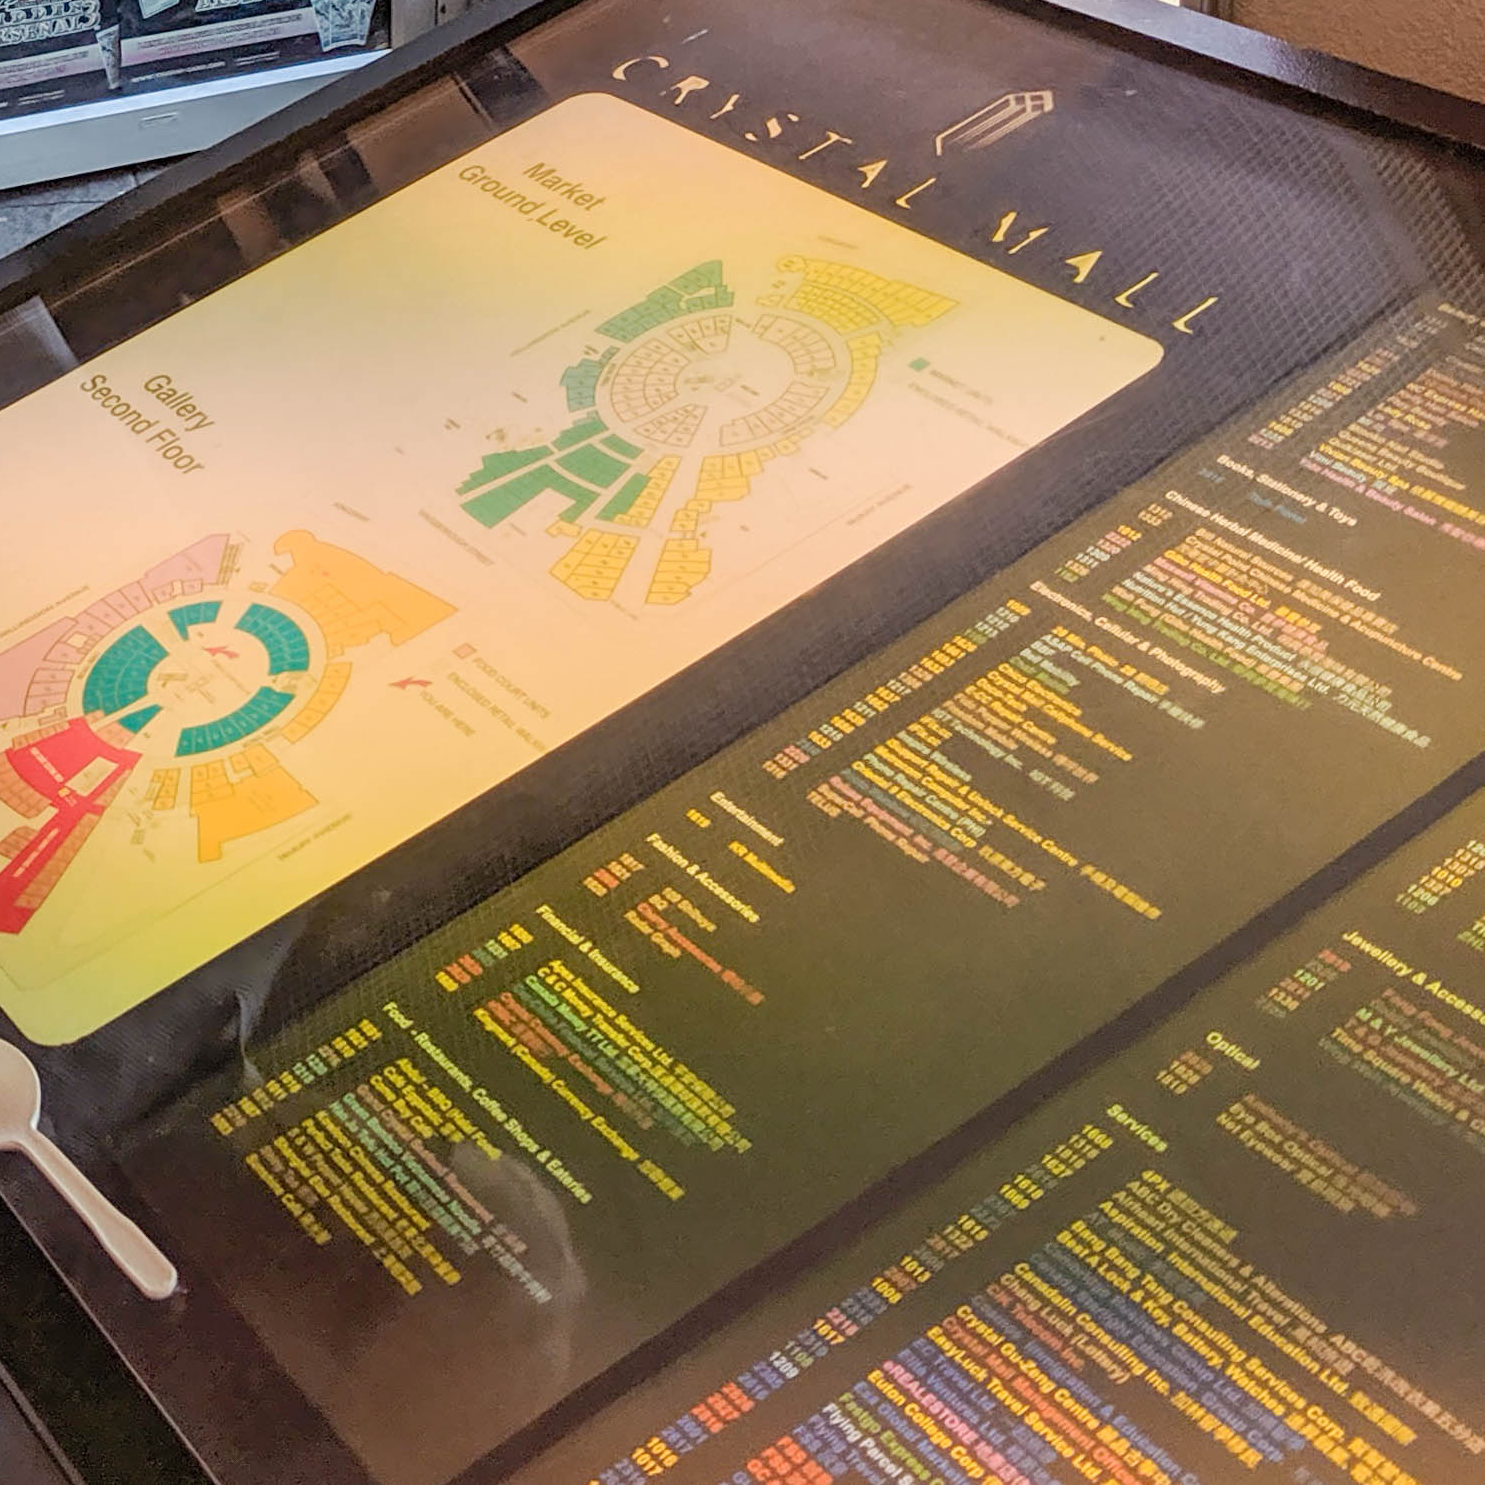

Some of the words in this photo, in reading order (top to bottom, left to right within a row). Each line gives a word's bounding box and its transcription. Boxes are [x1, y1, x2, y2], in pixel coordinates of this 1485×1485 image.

[458, 163, 537, 226] Ground
[535, 210, 607, 252] Level
[523, 160, 607, 212] Market
[613, 55, 937, 210] CRYSTAL
[992, 211, 1220, 335] MALL
[78, 374, 160, 440] Second
[156, 428, 205, 479] Floor
[142, 372, 217, 432] Gallery
[1213, 455, 1260, 479] Books,
[1253, 474, 1318, 507] Stationery
[1323, 508, 1360, 527] Toys
[1162, 490, 1214, 517] Chinese
[1207, 513, 1252, 536] Herbal
[1301, 560, 1348, 584] Health
[1342, 580, 1382, 602] Food
[1027, 581, 1098, 622] Electronics,
[1091, 616, 1143, 646] Cellular
[1144, 647, 1228, 695] Photography
[470, 657, 498, 677] FOOD
[493, 675, 526, 699] COURT
[521, 696, 552, 719] UNITS
[709, 791, 785, 847] Entertainment
[644, 833, 692, 869] Fashion
[692, 870, 762, 924] Accessories
[534, 904, 585, 945] Financial
[586, 949, 642, 995] Insurance
[1340, 928, 1415, 977] Jewellery
[1201, 1030, 1261, 1072] Optical
[381, 1002, 413, 1029] Food
[469, 1087, 510, 1123] Coffee
[500, 1118, 542, 1155] Shops
[543, 1158, 595, 1205] Eateries
[1105, 1104, 1172, 1153] Services
[1067, 1219, 1110, 1253] Bang
[1101, 1246, 1145, 1280] Bang
[1136, 1274, 1178, 1306] Tang
[1168, 1299, 1251, 1364] Consulting
[1243, 1357, 1310, 1410] Services
[1096, 1200, 1168, 1255] Aspiration
[1164, 1251, 1253, 1320] International
[1246, 1314, 1323, 1374] Education
[767, 1350, 800, 1380] 1209
[923, 1326, 991, 1384] EasyLuck
[984, 1378, 1029, 1416] Travel
[1021, 1411, 1078, 1459] Service
[952, 1304, 1004, 1347] Crystal
[1051, 1387, 1102, 1430] Centre
[628, 1446, 662, 1479] 1017
[643, 1435, 678, 1468] 1016
[819, 1403, 865, 1444] Flying
[857, 1437, 904, 1479] Parcel
[899, 1402, 955, 1451] College
